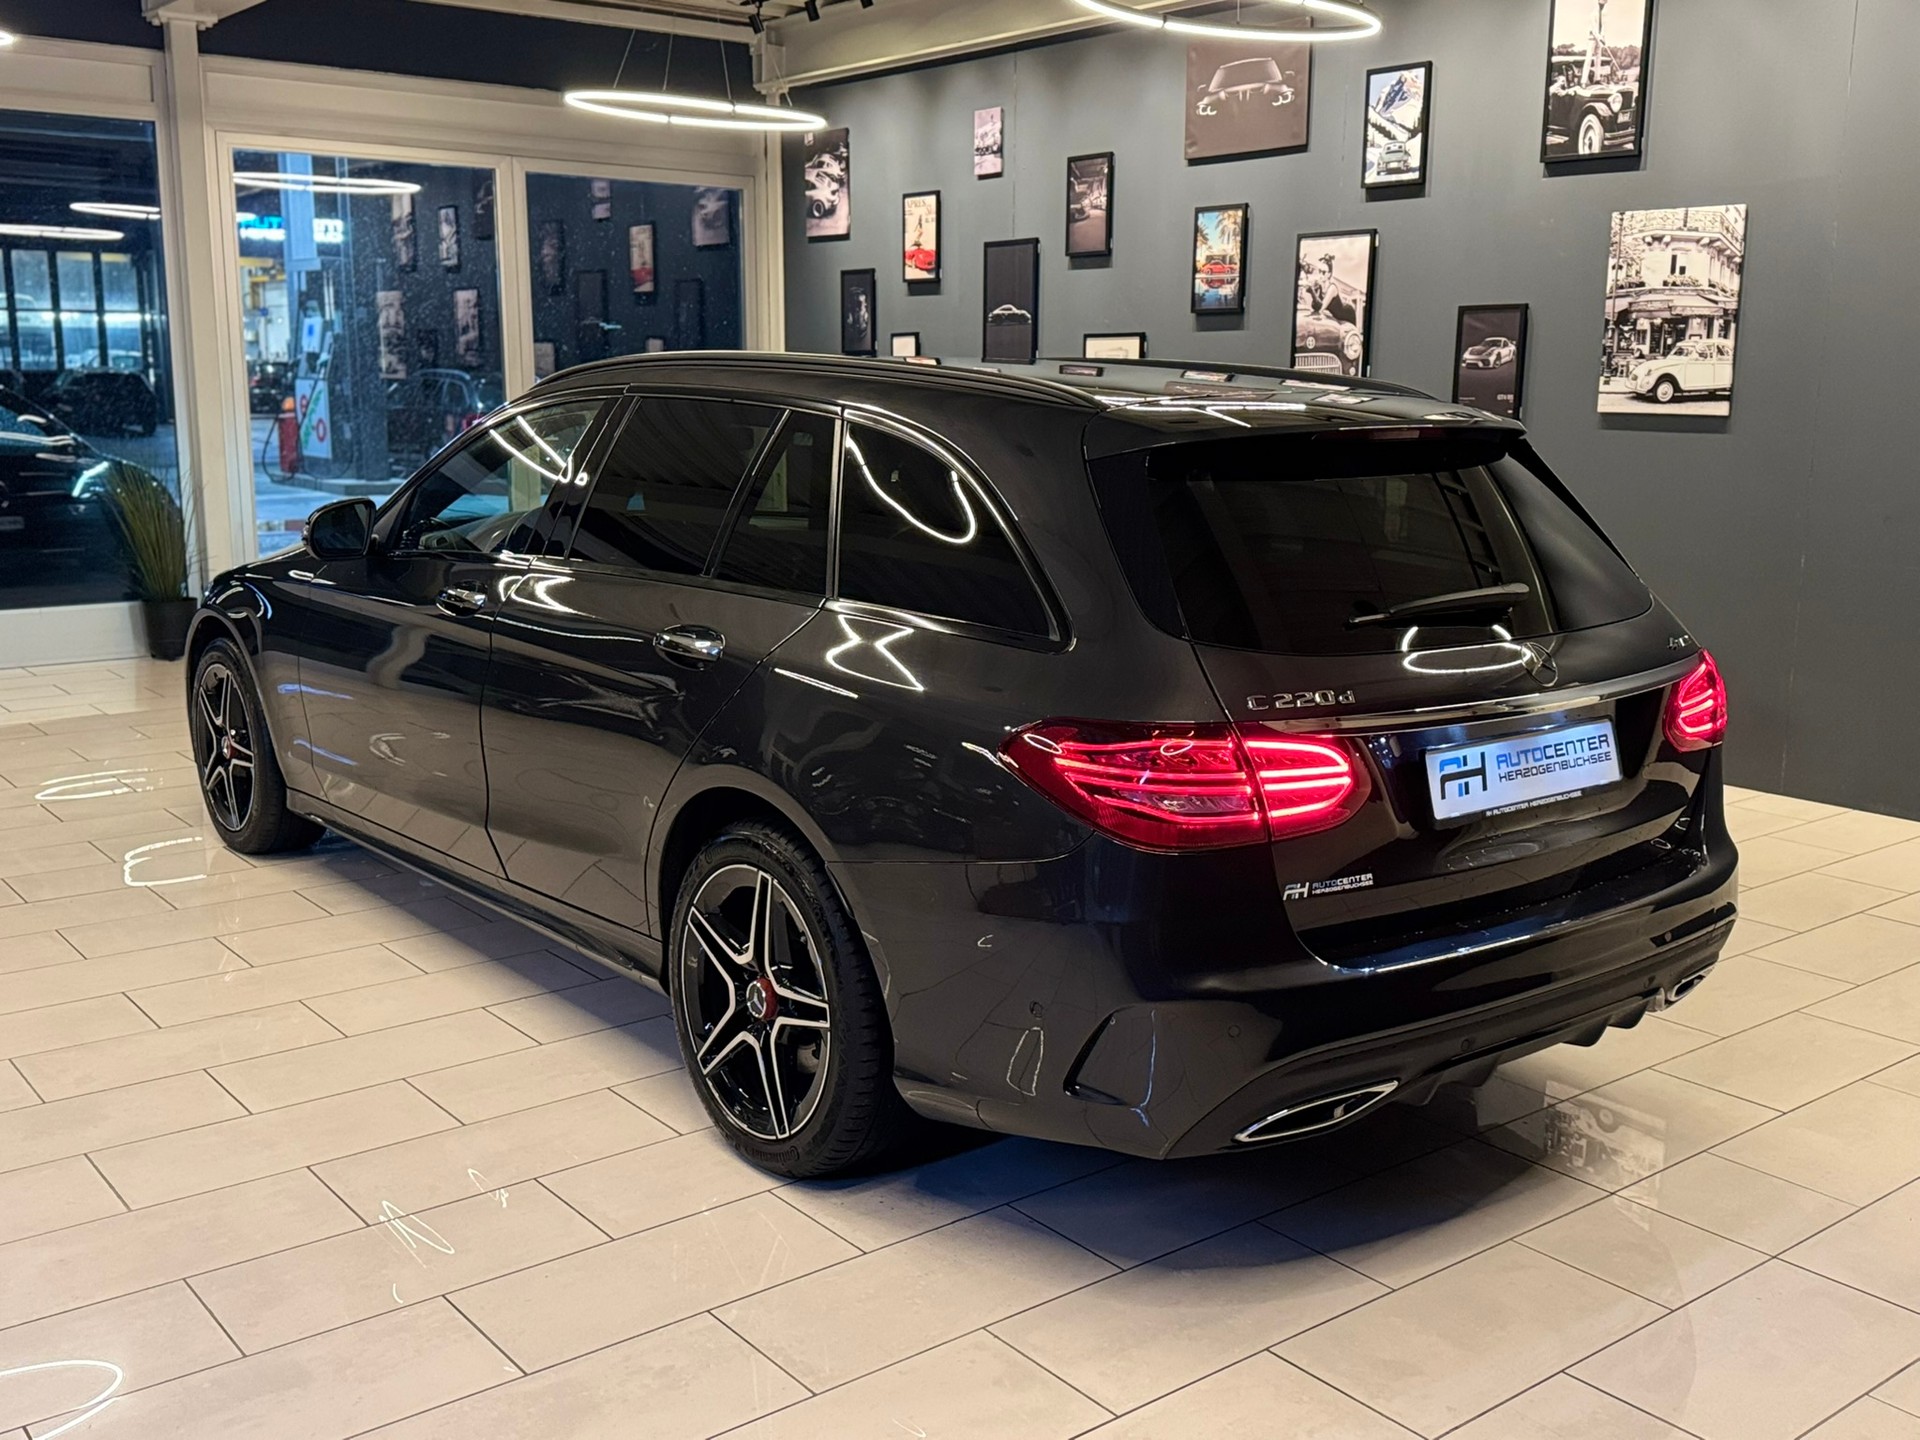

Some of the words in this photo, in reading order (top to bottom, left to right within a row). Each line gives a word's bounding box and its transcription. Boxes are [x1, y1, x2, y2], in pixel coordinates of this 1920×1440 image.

[1246, 694, 1269, 711] C
[1496, 733, 1611, 770] AUTOCENTER
[1498, 750, 1613, 783] HERZOGENBUCHSEE
[1312, 873, 1374, 890] AUTOCENTER
